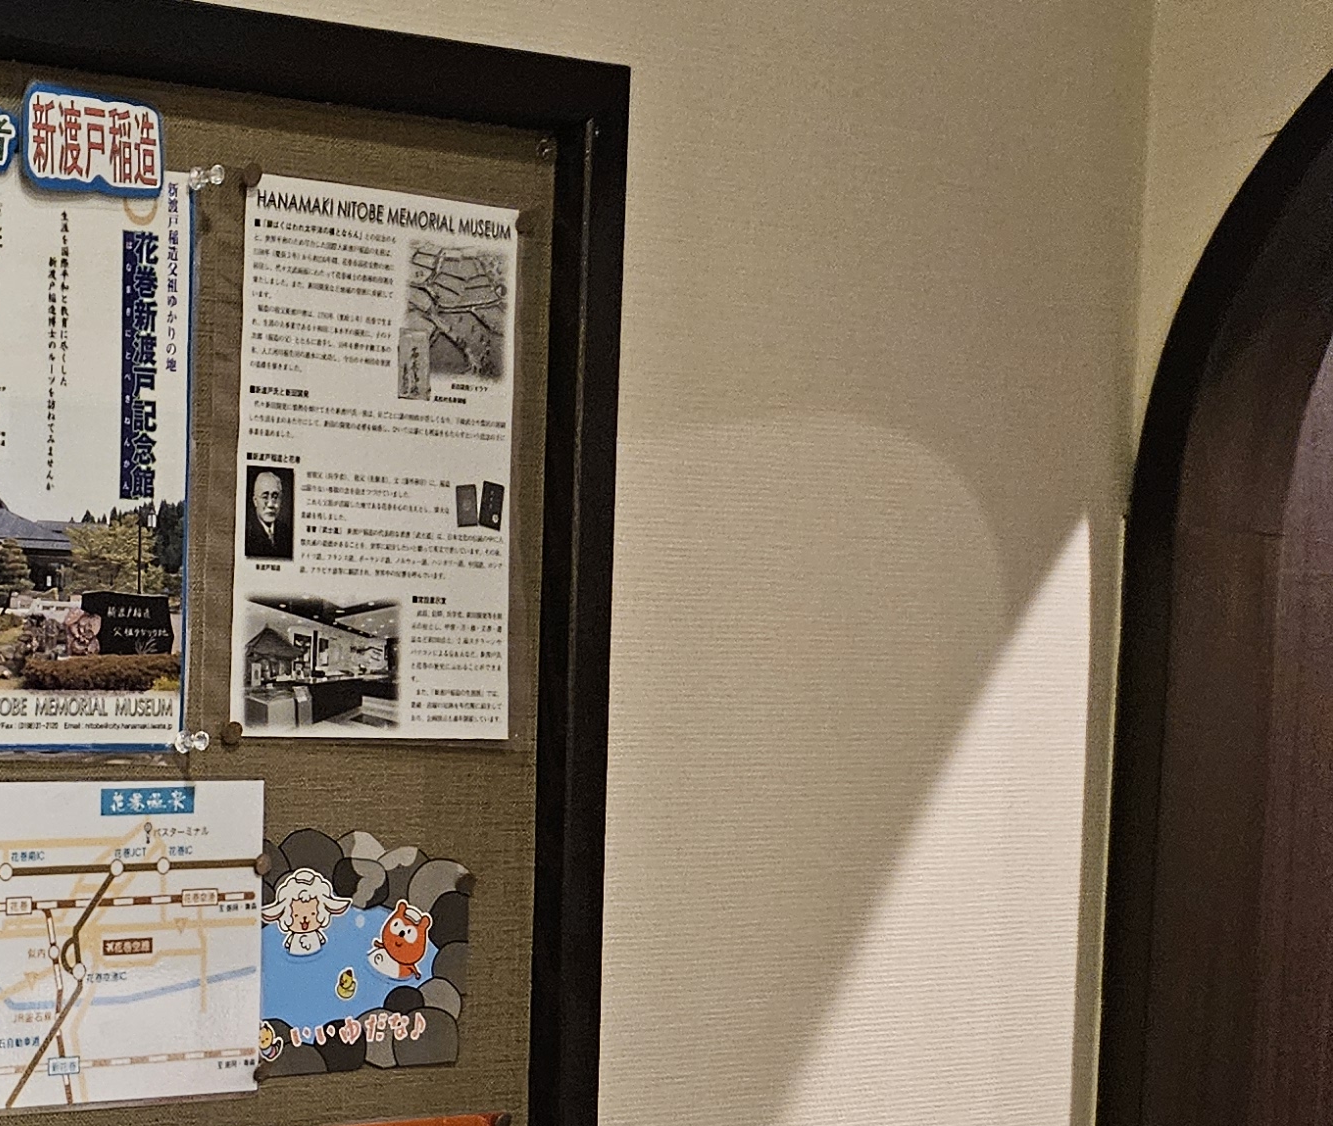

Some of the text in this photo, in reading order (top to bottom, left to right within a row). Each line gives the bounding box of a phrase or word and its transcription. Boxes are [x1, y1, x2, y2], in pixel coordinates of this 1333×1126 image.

[32, 95, 158, 187] 新渡戸稲造
[257, 190, 512, 240] HANAMAKI NITOBE MEMORIAL MUSEUM
[165, 181, 179, 372] 新渡戸稲造父祖ゆかりの地
[132, 231, 159, 499] 花巻新渡戸記念館
[35, 698, 107, 717] MEMORIAL
[115, 698, 173, 717] MUSEUM
[110, 791, 186, 811] 花巻温泉
[154, 826, 209, 837] バスターミナル
[114, 847, 147, 858] 花巻JCT
[169, 845, 193, 856] 花巻IC
[10, 901, 28, 912] 花巻
[28, 948, 46, 959] 似内
[87, 972, 127, 983] 花巻空港IC
[13, 1012, 52, 1022] JR釜石線
[52, 1061, 77, 1072] 新花巻
